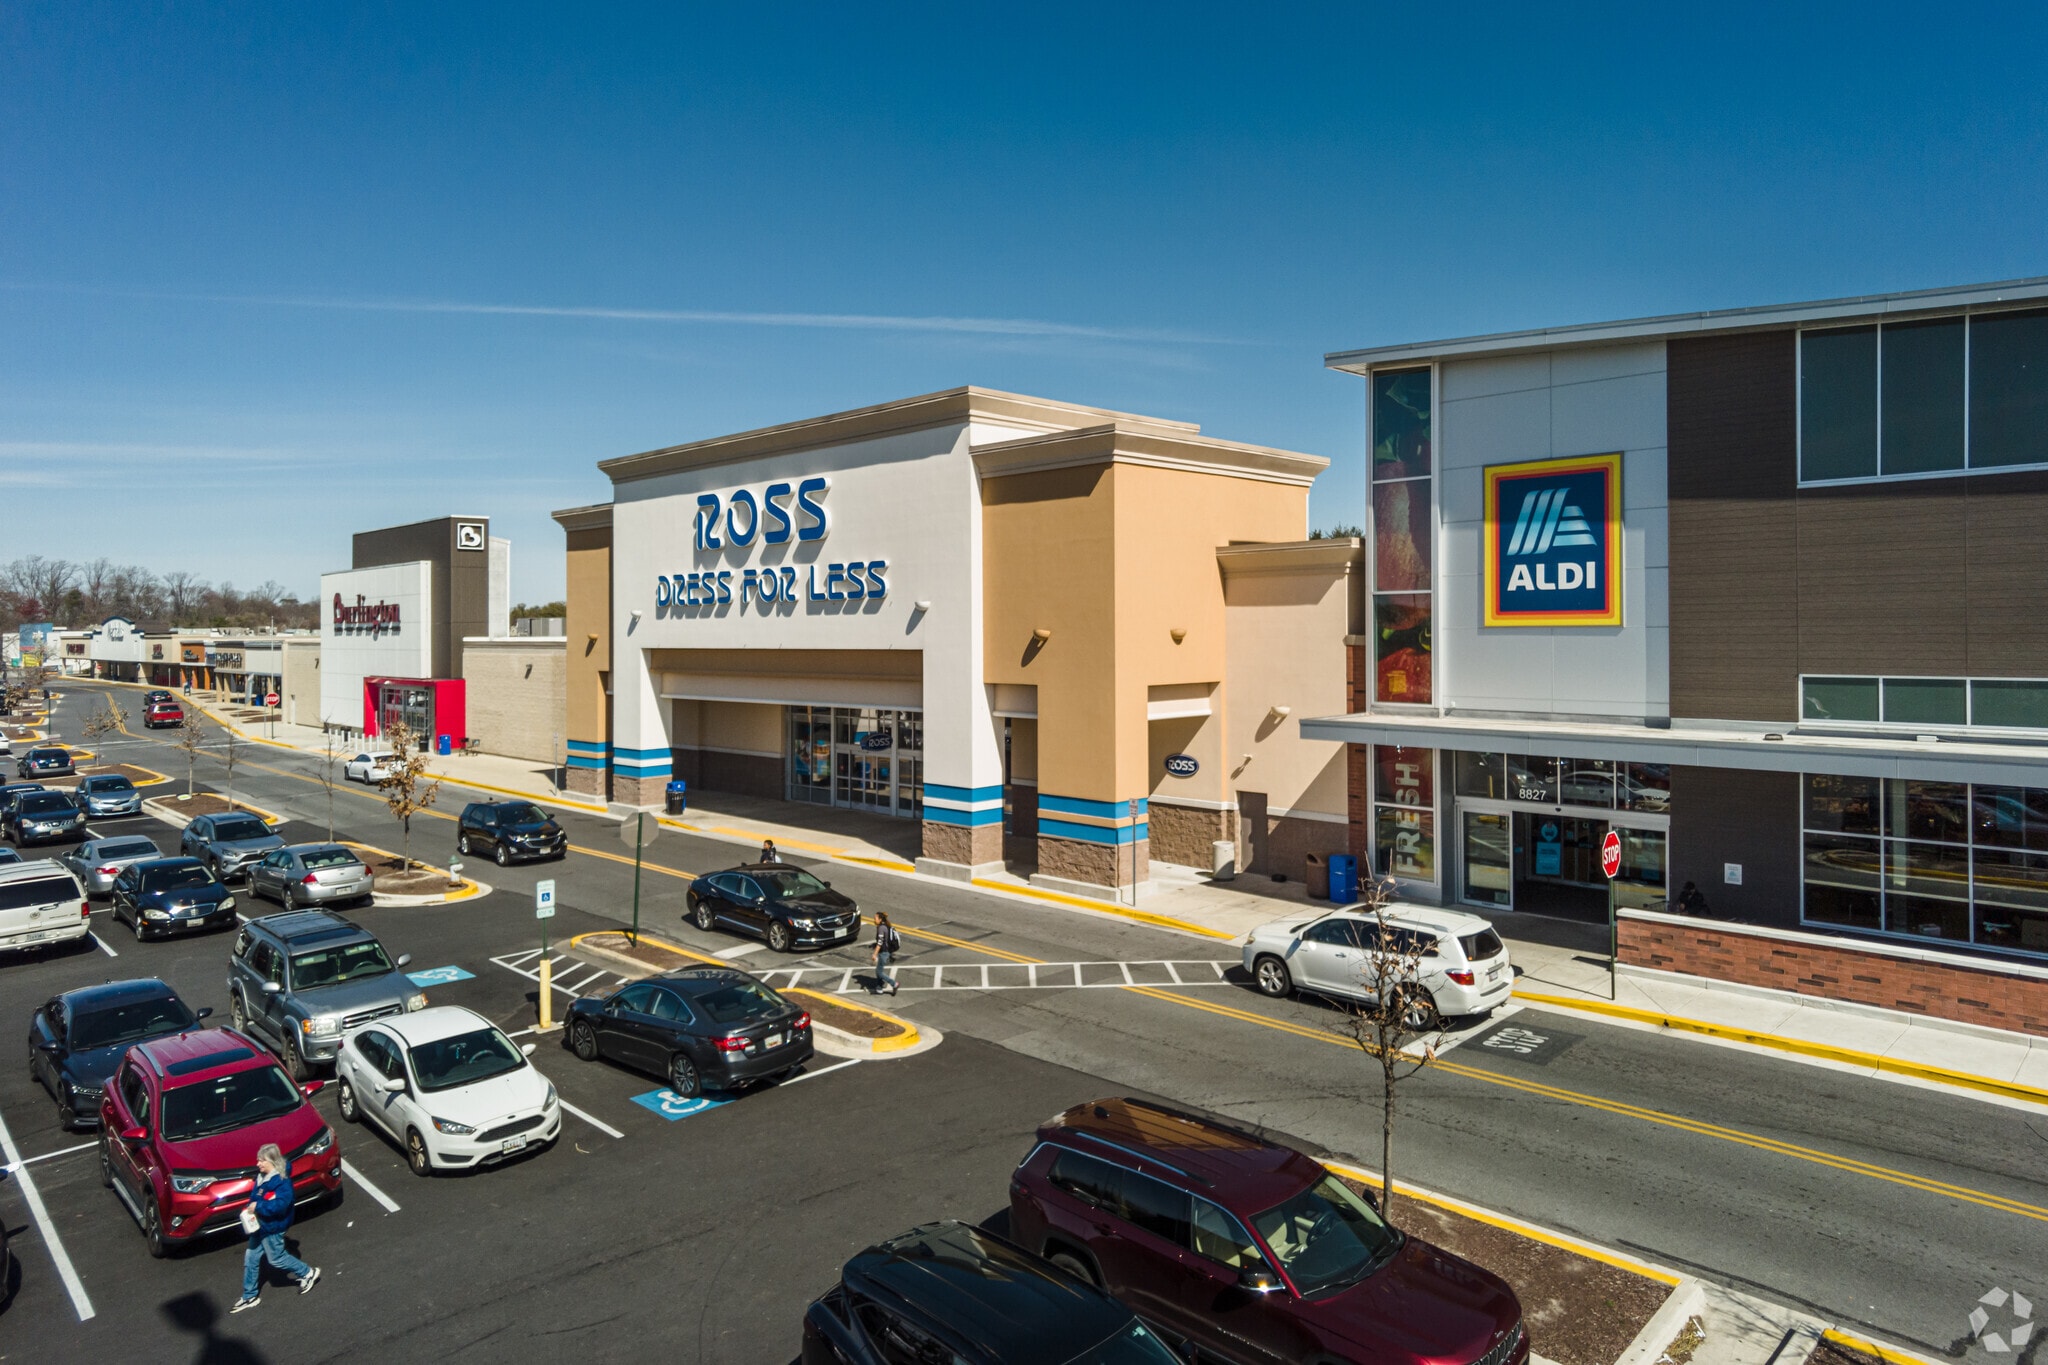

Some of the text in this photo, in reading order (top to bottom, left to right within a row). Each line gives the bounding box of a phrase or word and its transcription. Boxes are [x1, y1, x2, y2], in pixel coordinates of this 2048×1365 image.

[696, 477, 830, 551] ROSS
[657, 560, 888, 608] DRESS FOR LESS
[1507, 561, 1597, 592] ALDI
[333, 592, 400, 634] Burlington
[868, 736, 891, 748] ROSS
[1167, 759, 1195, 772] ROSS
[1518, 787, 1547, 802] 8827
[1395, 763, 1420, 874] FRESH
[1604, 844, 1619, 865] STOP
[1482, 1027, 1550, 1054] STOP
